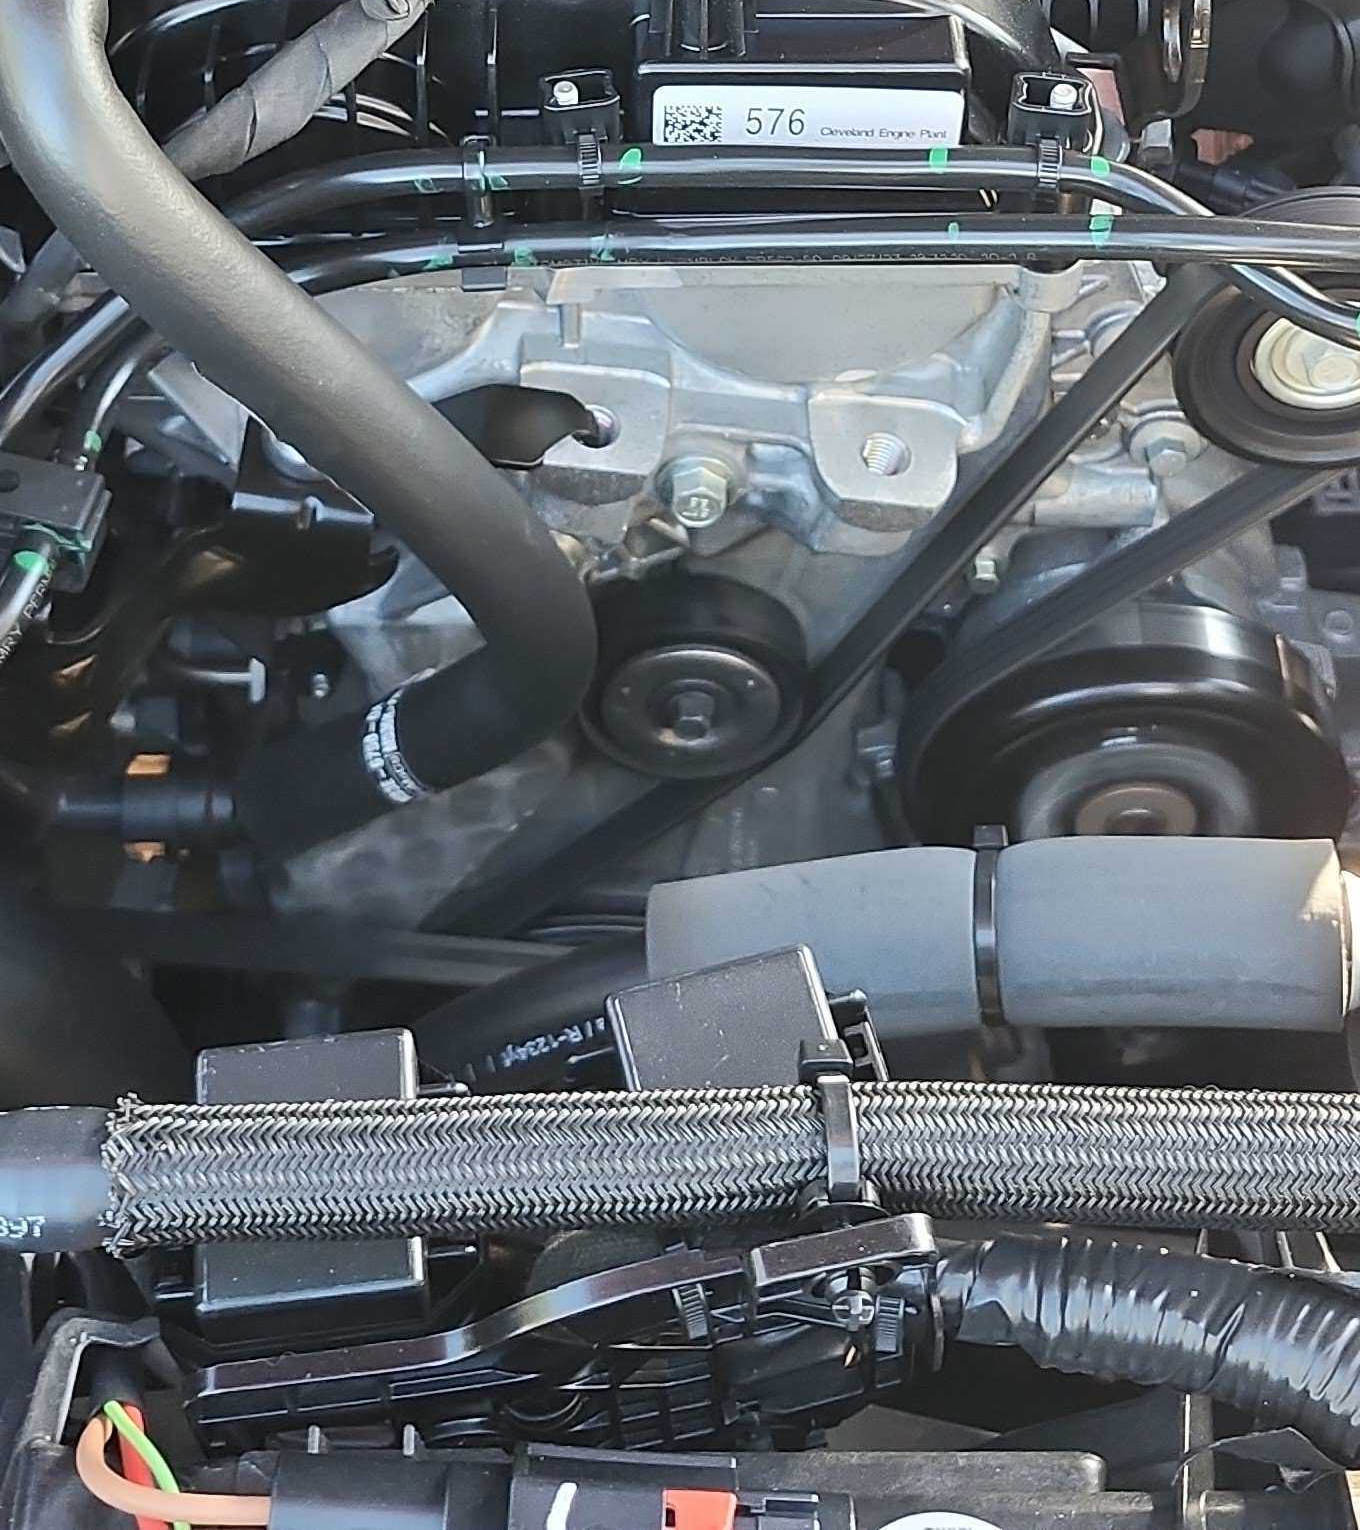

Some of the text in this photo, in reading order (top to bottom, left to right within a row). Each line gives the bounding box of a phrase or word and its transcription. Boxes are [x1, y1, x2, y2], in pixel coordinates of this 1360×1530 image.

[745, 107, 948, 140] 576 Cleveland Engine Plant
